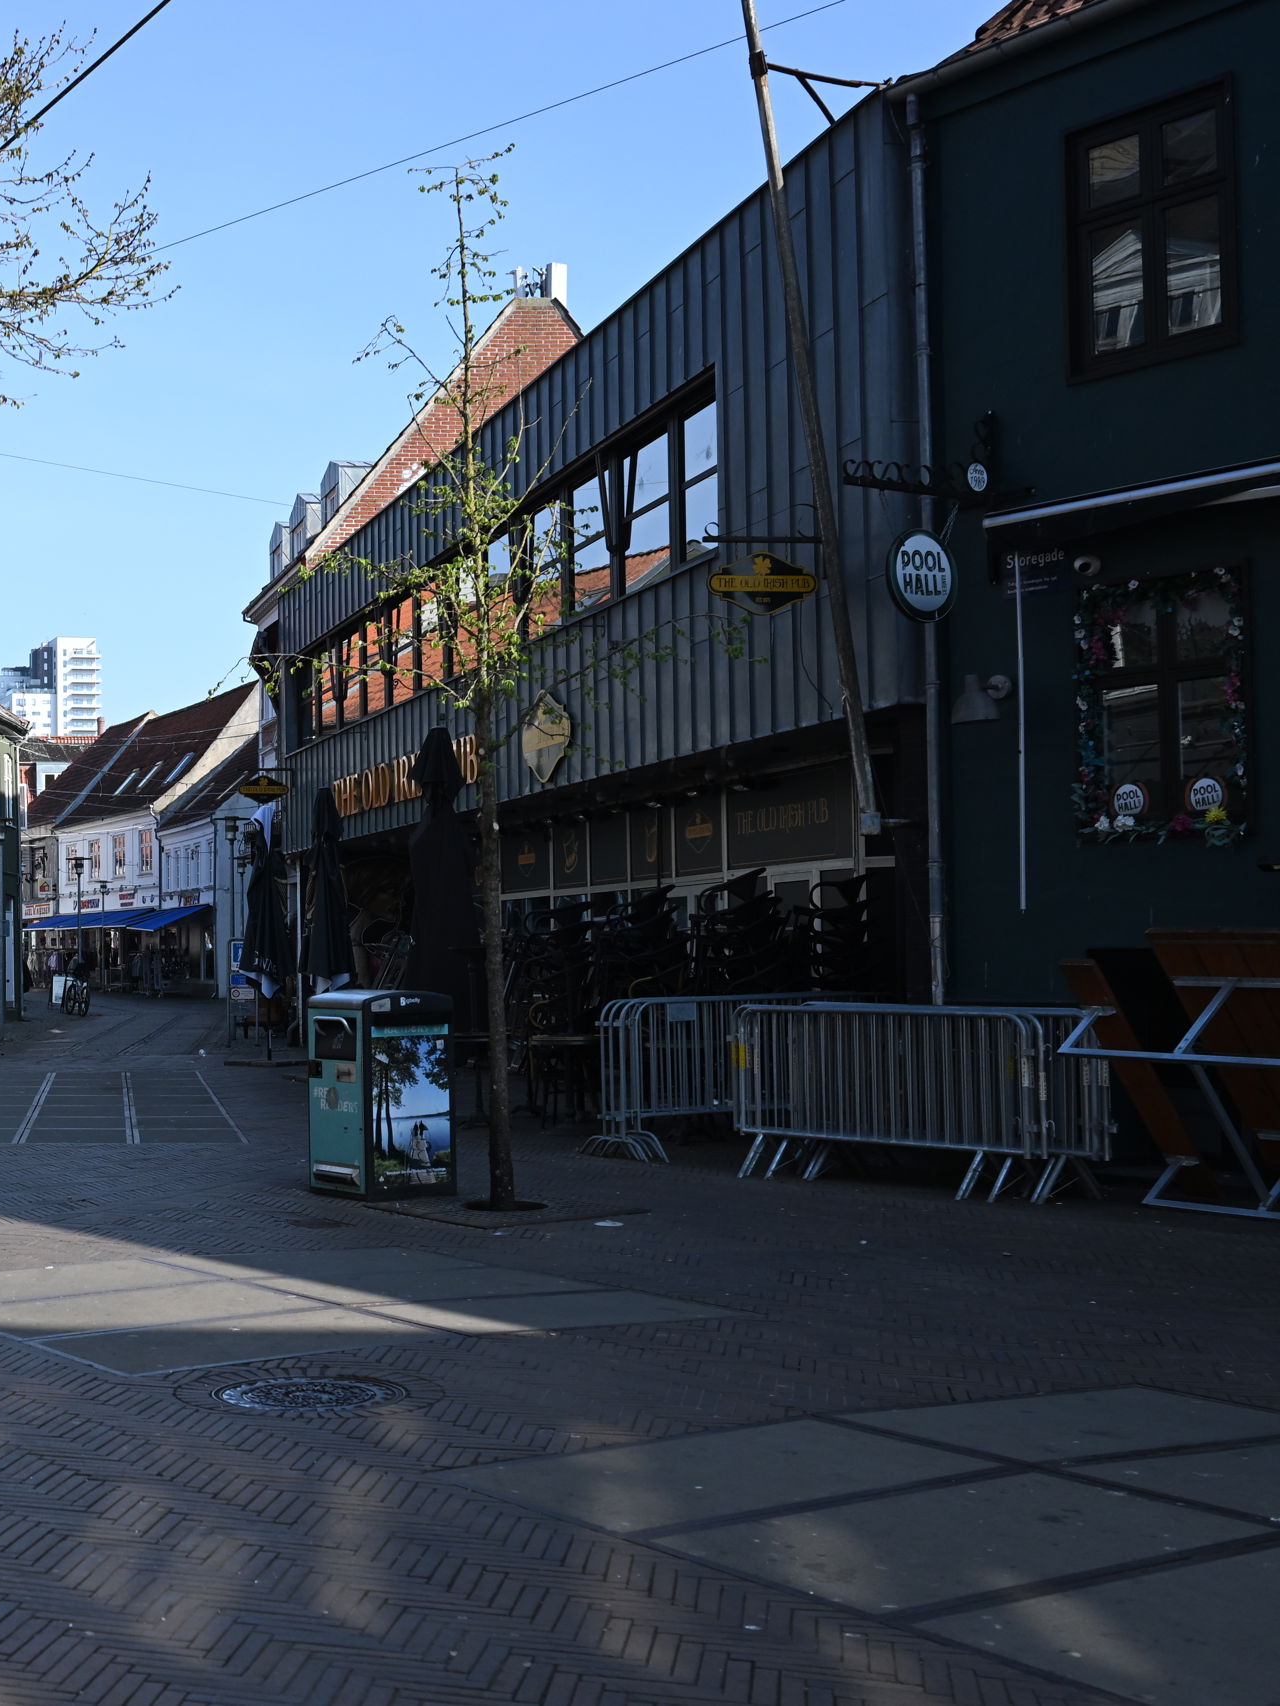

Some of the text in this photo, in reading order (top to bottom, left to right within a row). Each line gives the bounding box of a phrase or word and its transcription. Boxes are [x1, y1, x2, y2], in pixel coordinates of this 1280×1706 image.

[901, 550, 946, 573] POOL
[1006, 547, 1065, 569] Soregade
[716, 577, 736, 588] THE
[903, 572, 942, 596] HALL
[333, 773, 359, 818] THE
[361, 762, 390, 811] OLD
[1116, 789, 1140, 801] POOL
[1193, 784, 1218, 797] POOL
[1117, 800, 1138, 812] HALL
[1194, 796, 1217, 808] HALL
[735, 798, 829, 835] THE OLD IRISH PUB
